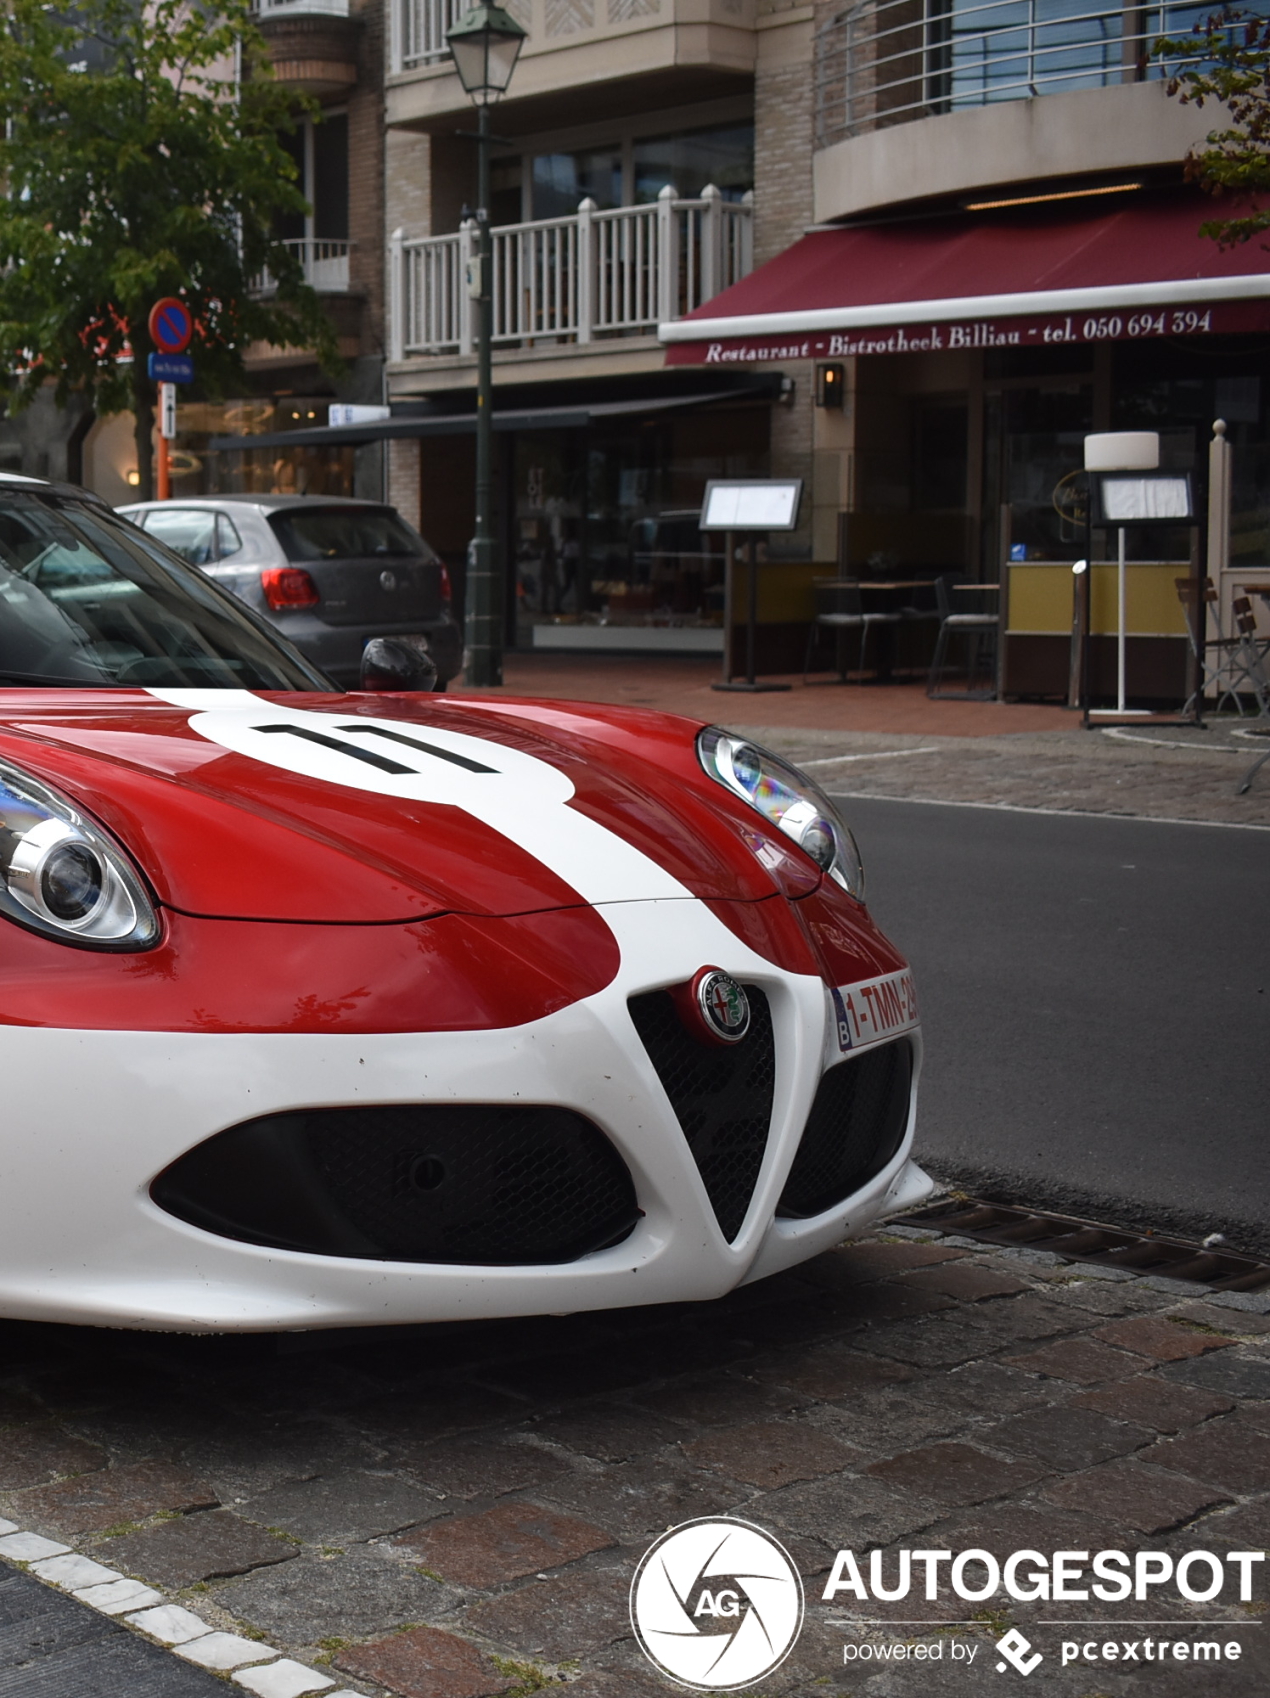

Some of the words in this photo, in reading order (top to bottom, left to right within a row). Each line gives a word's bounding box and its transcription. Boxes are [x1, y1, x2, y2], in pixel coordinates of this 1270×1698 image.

[705, 343, 809, 363] Restaurant
[948, 324, 1020, 349] Billiau
[1043, 318, 1076, 343] tel.
[1083, 317, 1122, 339] 050
[1127, 312, 1165, 337] 694
[1172, 309, 1211, 333] 394
[248, 724, 503, 775] 11
[838, 1021, 850, 1046] B
